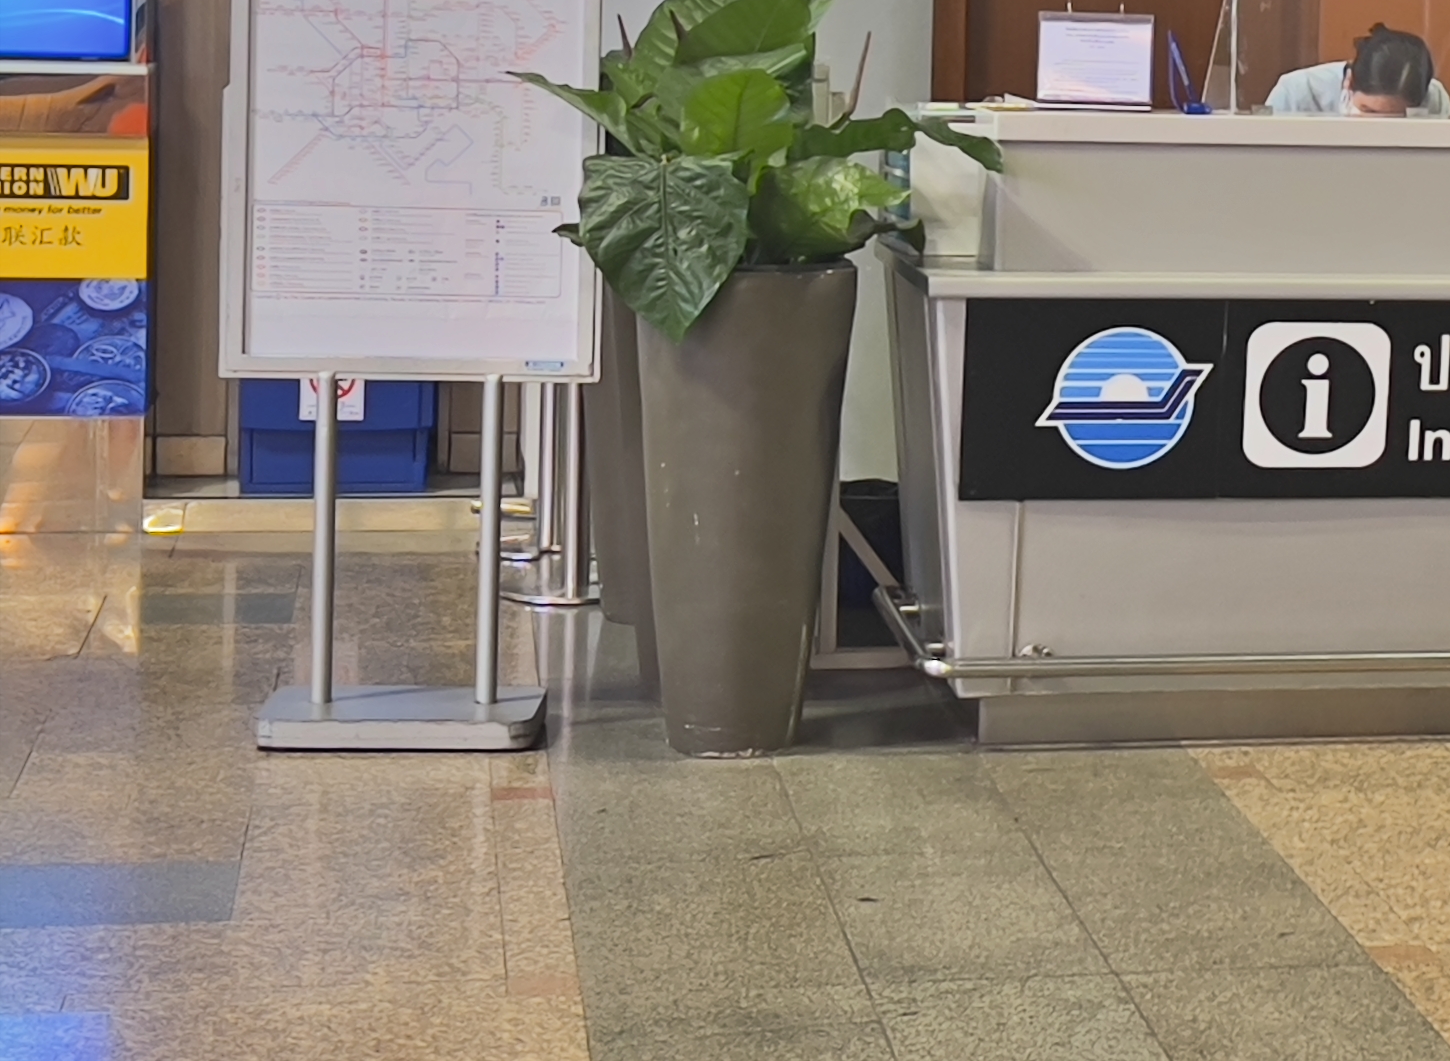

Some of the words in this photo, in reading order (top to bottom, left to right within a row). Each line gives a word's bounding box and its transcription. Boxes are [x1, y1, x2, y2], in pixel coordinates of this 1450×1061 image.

[0, 181, 44, 196] ION
[47, 167, 119, 198] WU
[4, 206, 44, 215] money
[48, 204, 64, 215] for
[67, 205, 102, 215] better
